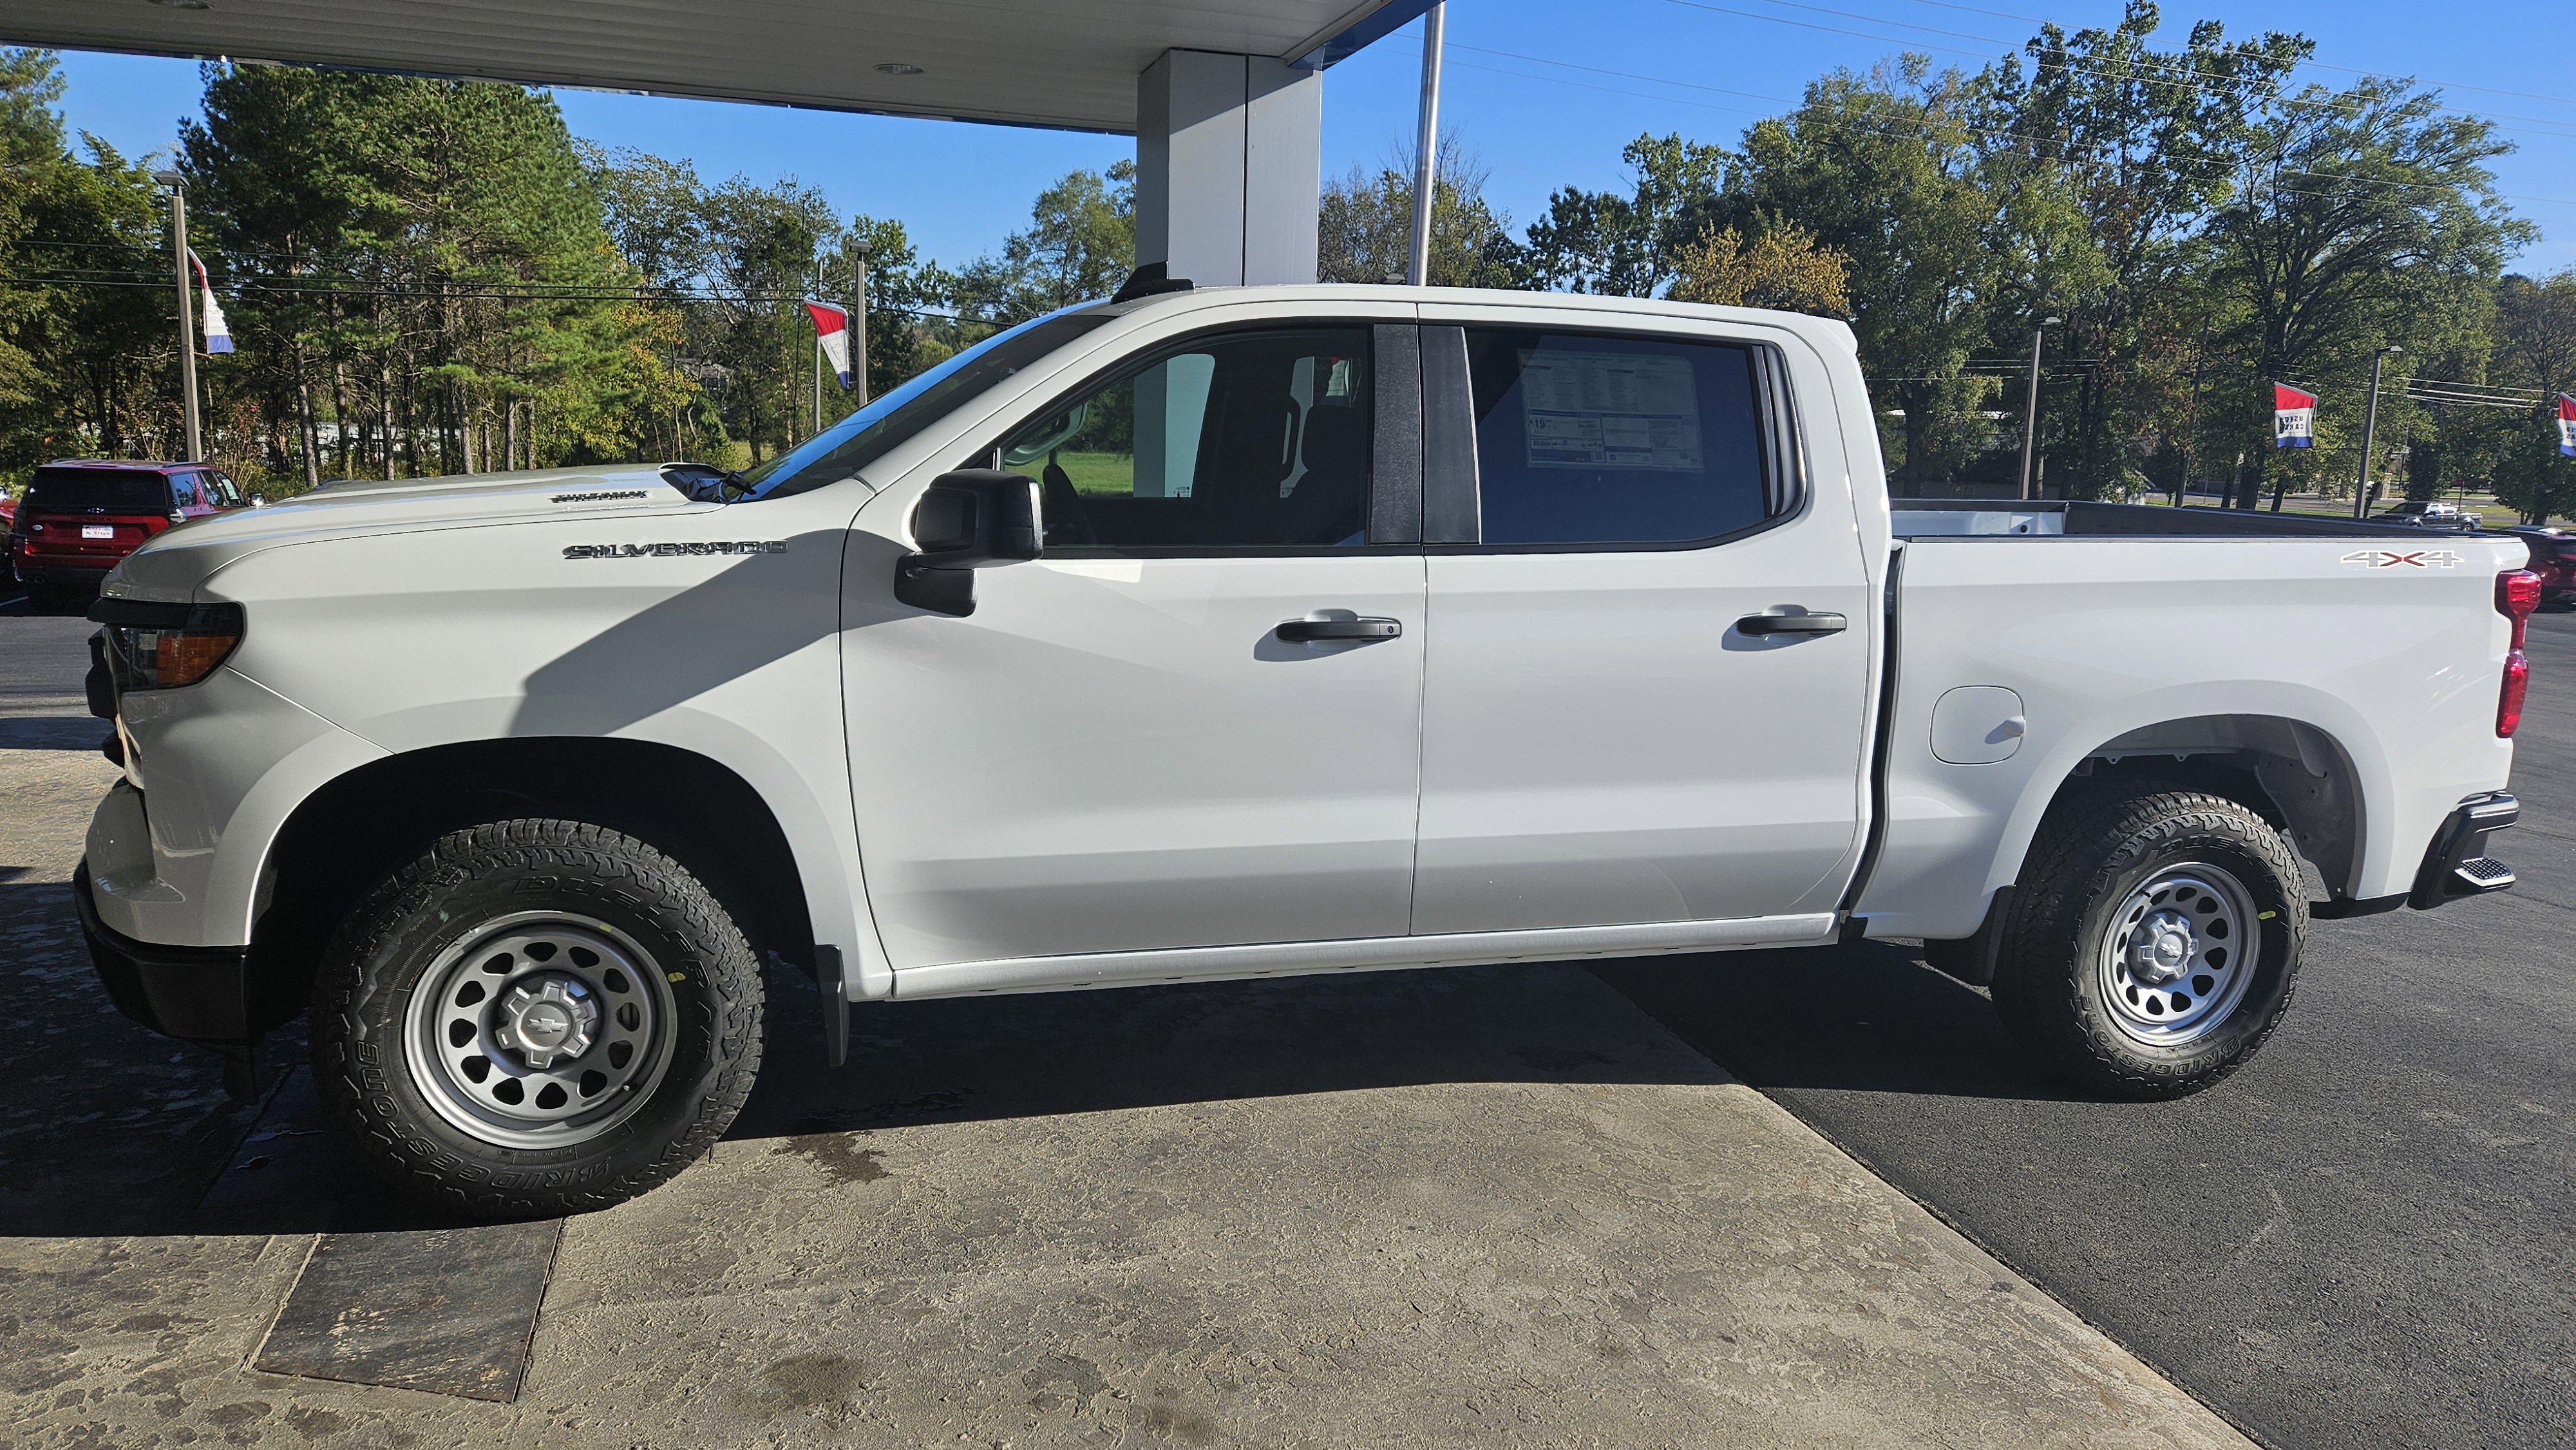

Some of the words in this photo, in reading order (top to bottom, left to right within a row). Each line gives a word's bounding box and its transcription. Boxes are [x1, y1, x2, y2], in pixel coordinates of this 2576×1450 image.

[562, 540, 789, 560] SILVERADO
[2341, 550, 2465, 569] 4X4
[2080, 995, 2240, 1076] BRIDGESTONE
[354, 1041, 610, 1190] BRIDGESTONE
